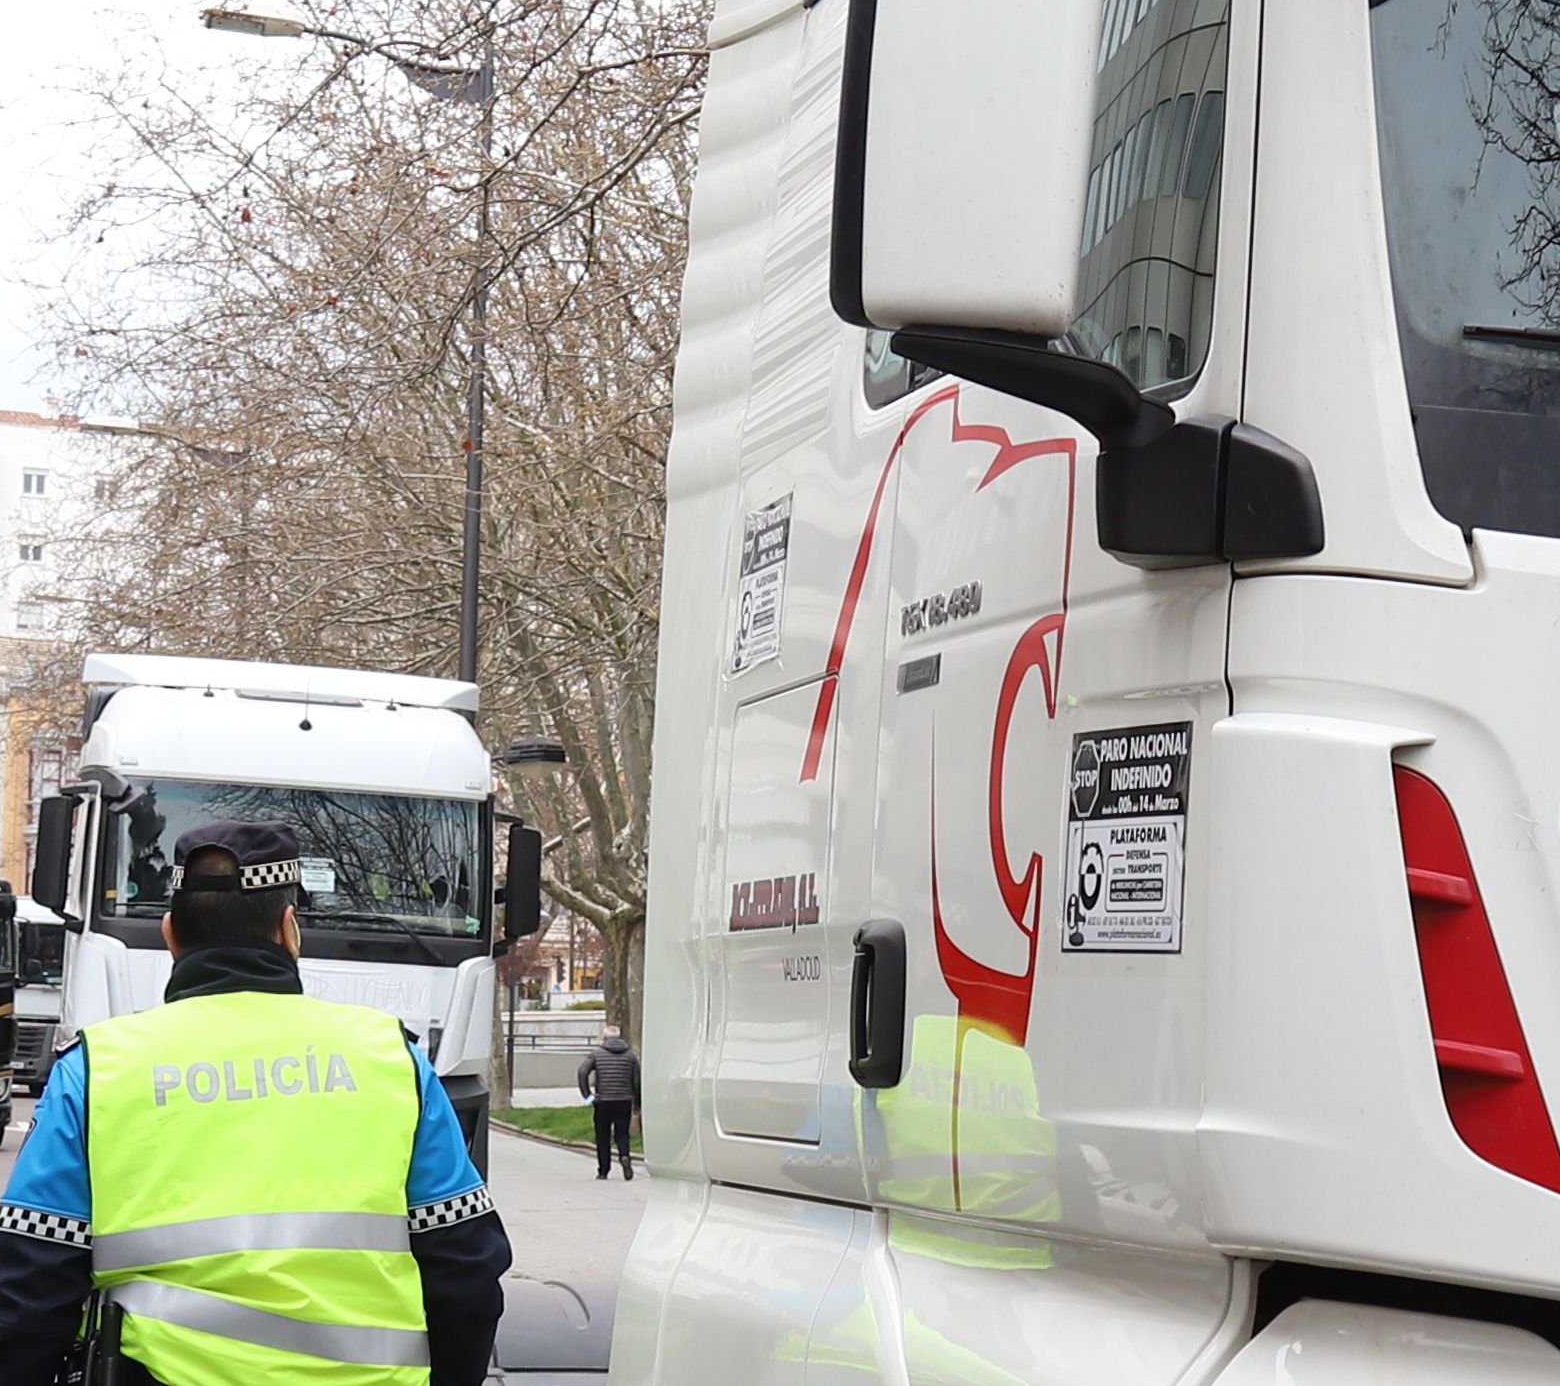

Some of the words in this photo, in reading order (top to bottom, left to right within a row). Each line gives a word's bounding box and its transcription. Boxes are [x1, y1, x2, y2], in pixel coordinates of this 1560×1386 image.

[1099, 737, 1128, 762] PARO
[1129, 732, 1188, 760] NACIONAL
[1074, 769, 1097, 790] STOP
[1110, 764, 1172, 791] INDEFINIDO
[1117, 795, 1132, 814] 00h
[1139, 795, 1148, 812] 14
[1154, 793, 1179, 811] Marzo
[1110, 826, 1166, 843] PLATAFORMA
[153, 1044, 358, 1107] POLICÍA
